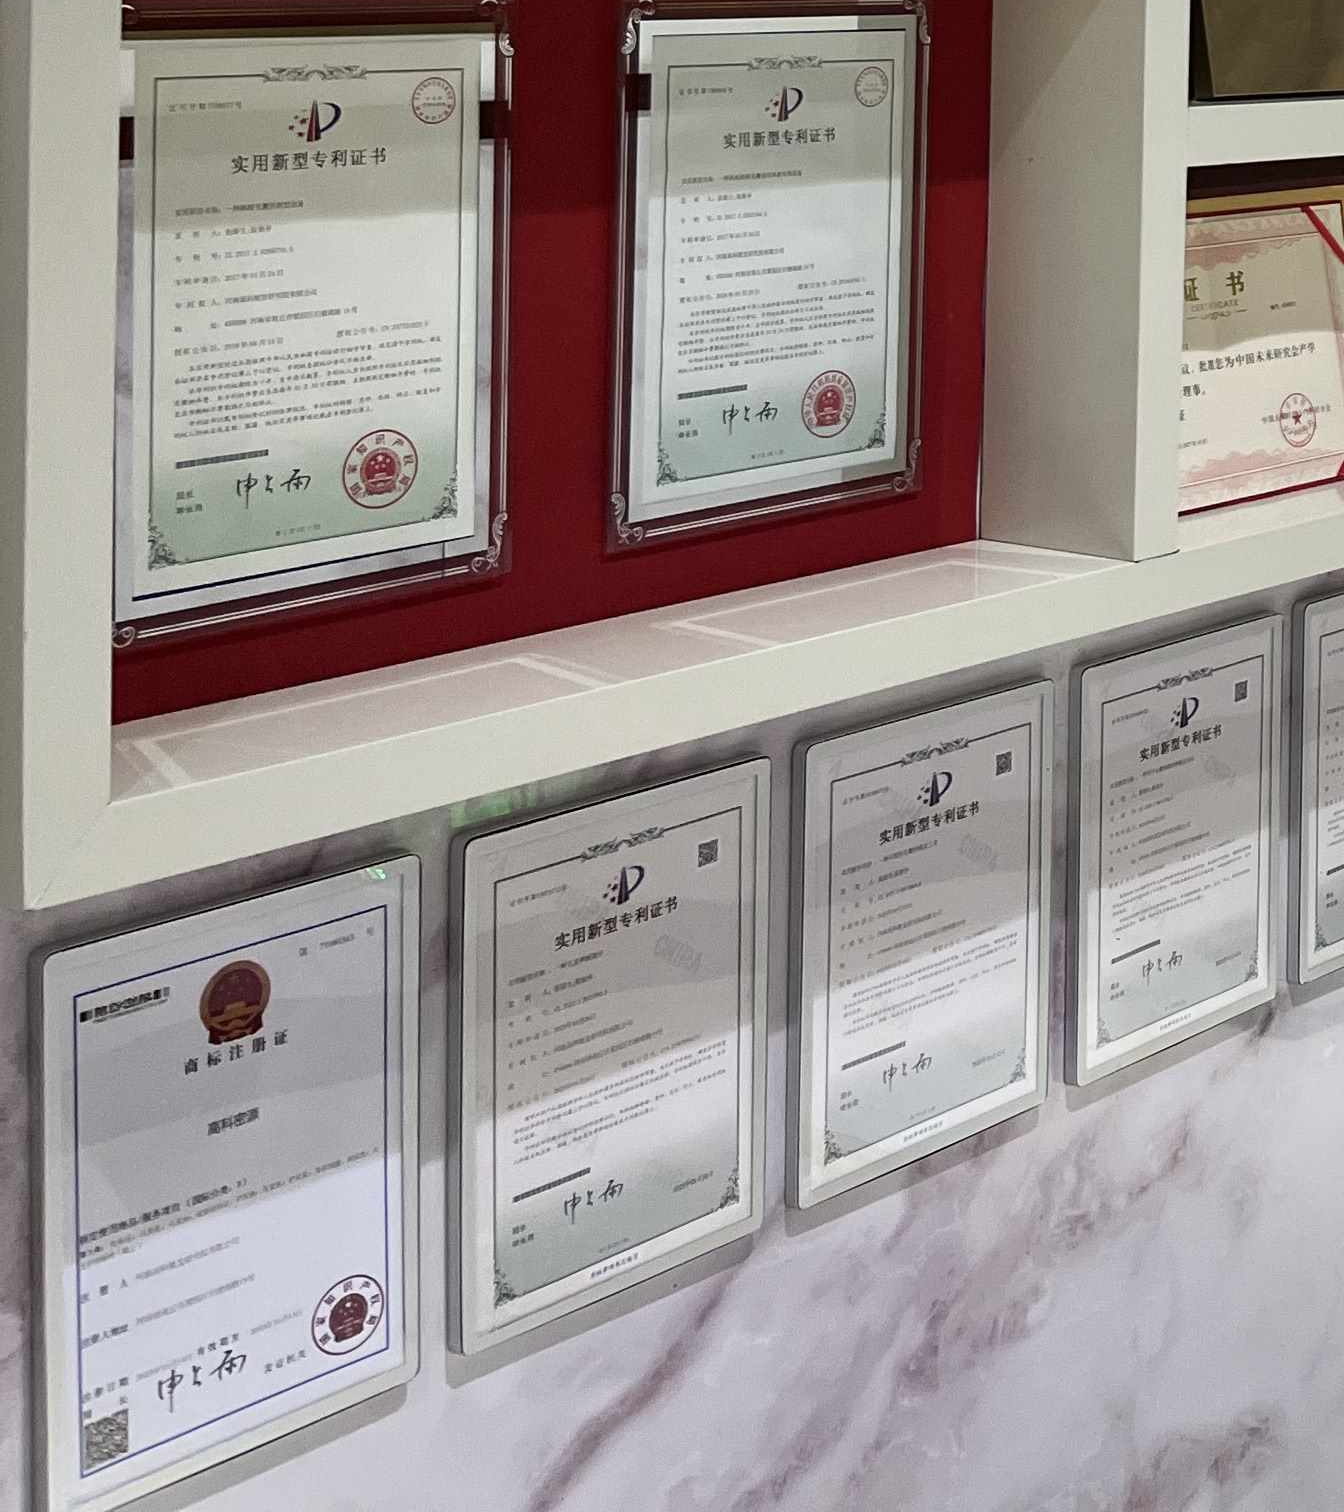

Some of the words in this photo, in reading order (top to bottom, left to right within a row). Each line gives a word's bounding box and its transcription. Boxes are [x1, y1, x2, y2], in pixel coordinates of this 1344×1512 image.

[723, 127, 836, 149] 实用新型专利证书
[231, 146, 387, 175] 实用新型专利证书
[1139, 724, 1222, 763] 实用新型专利证书
[879, 801, 980, 846] 实用新型专利证书
[554, 896, 679, 952] 实用新型专利证书
[184, 1029, 289, 1076] 商标注册证
